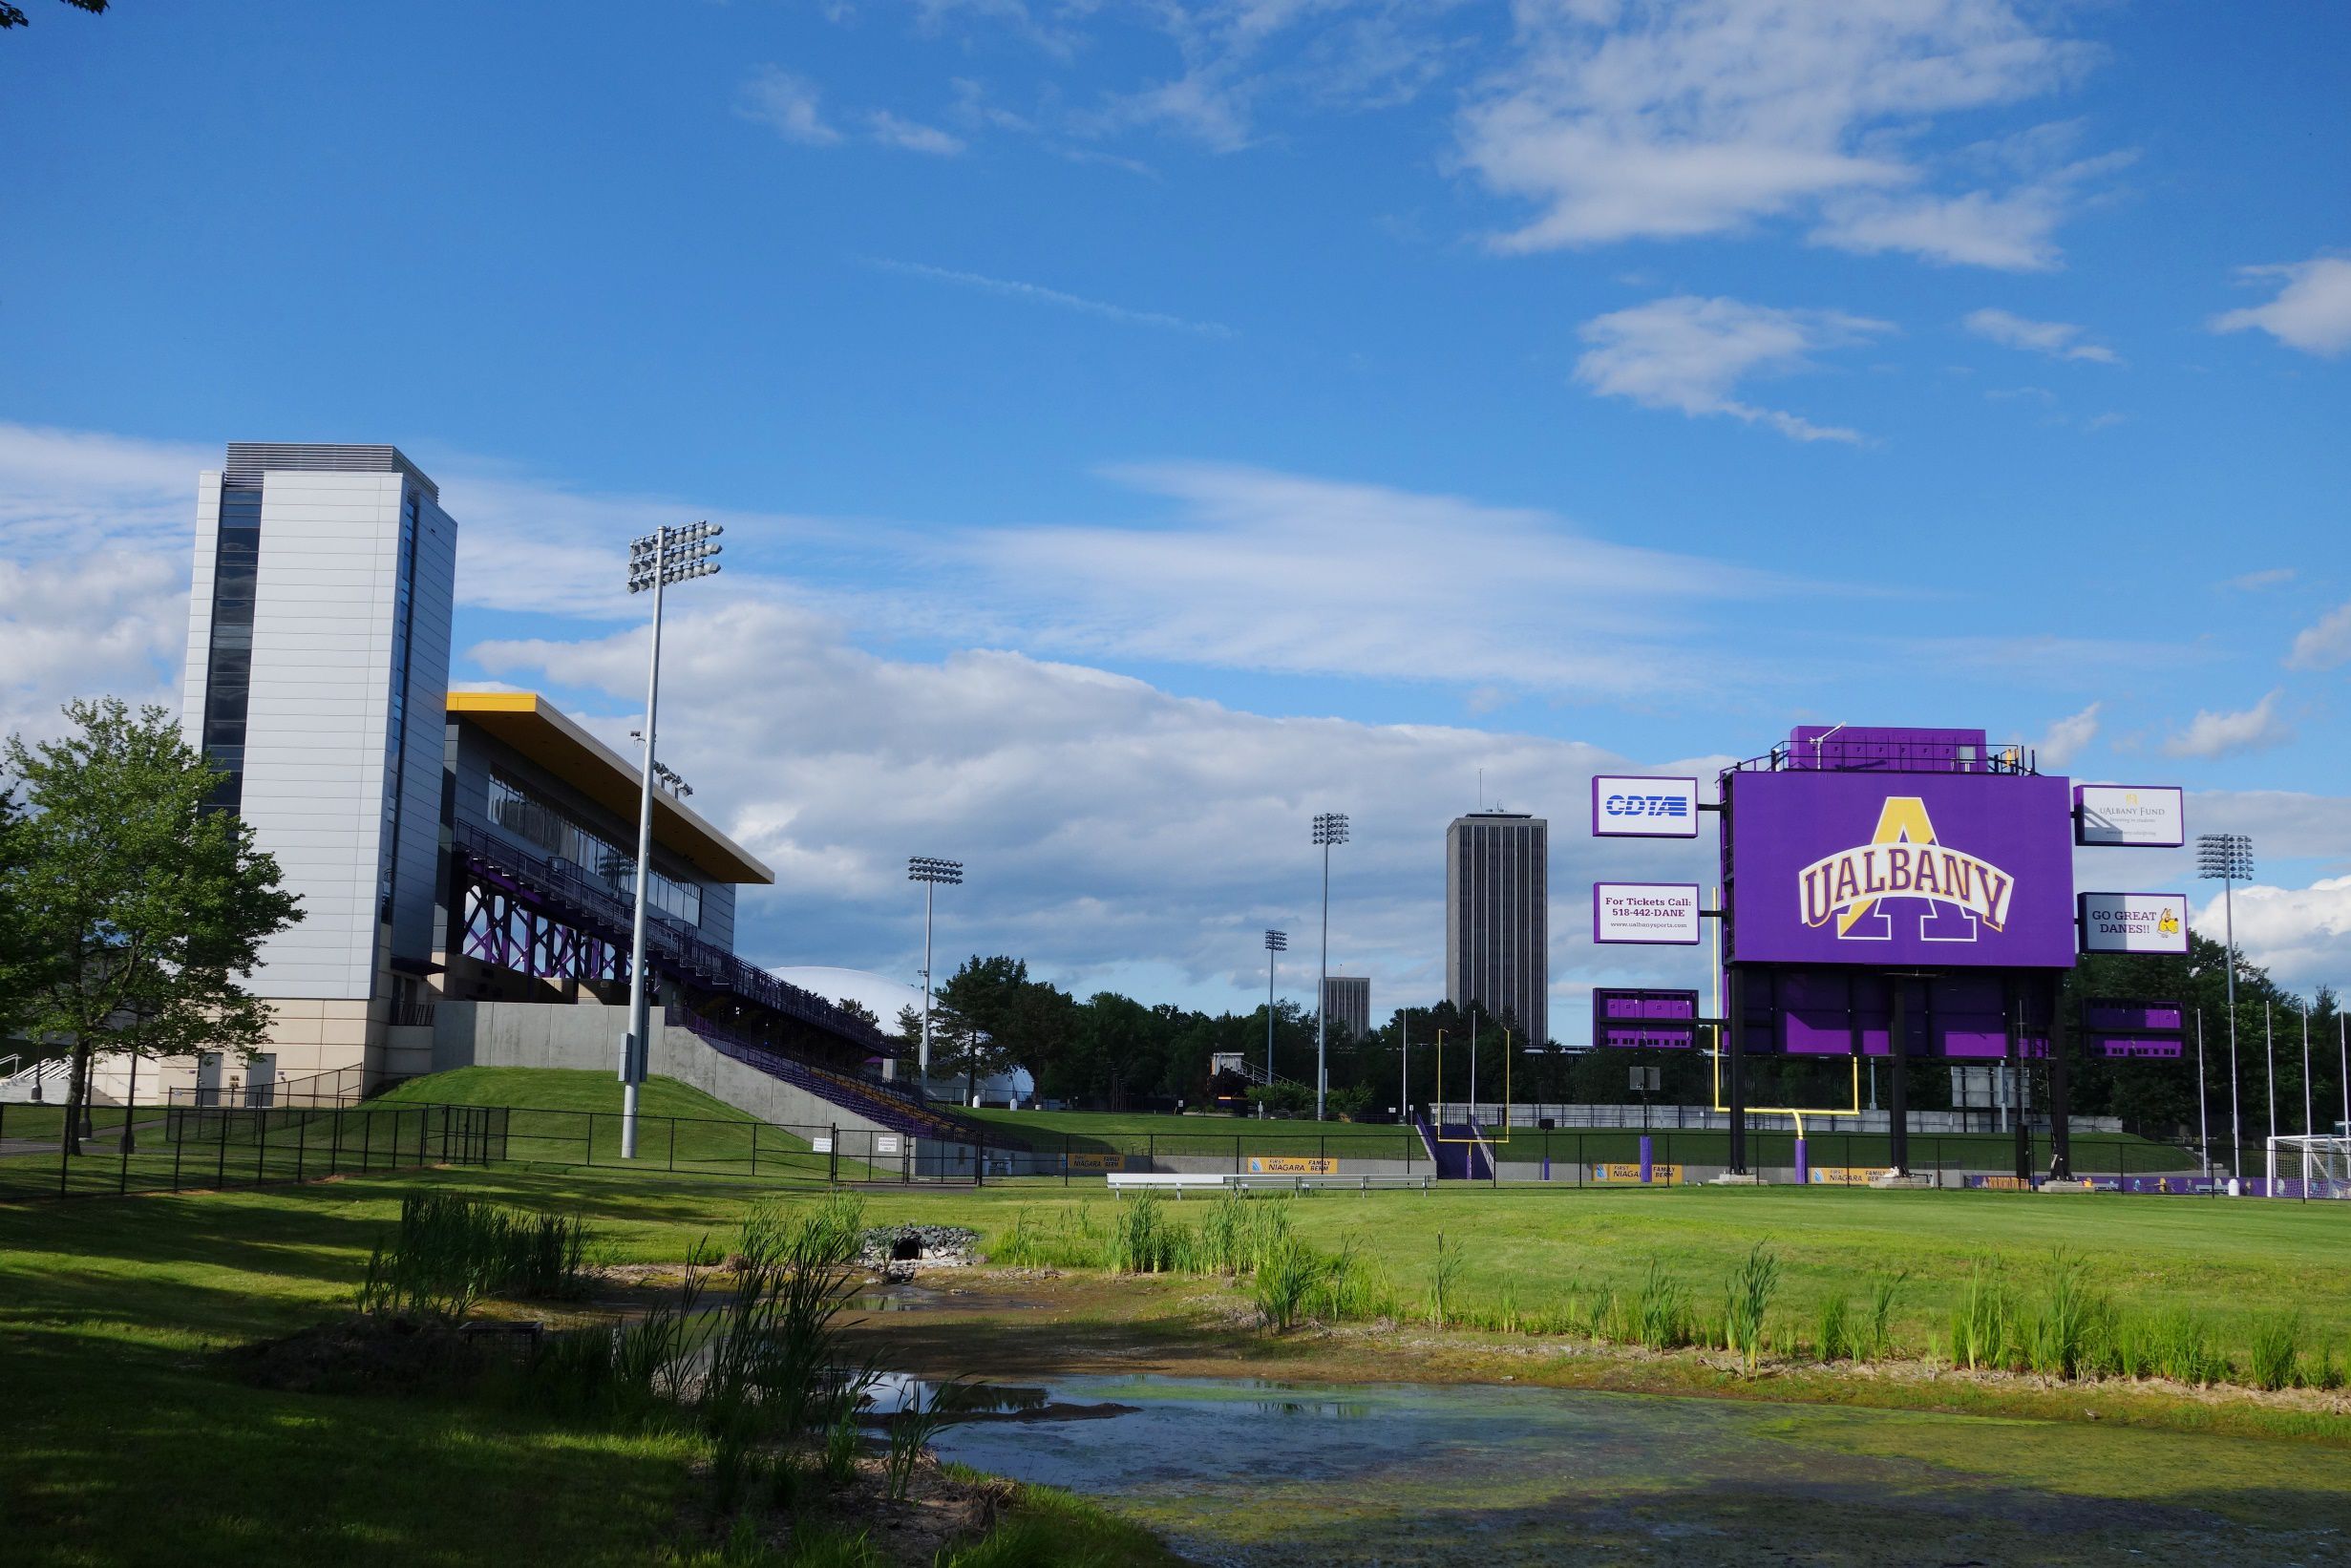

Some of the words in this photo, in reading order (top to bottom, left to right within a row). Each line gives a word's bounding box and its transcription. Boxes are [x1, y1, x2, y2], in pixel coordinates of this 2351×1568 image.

[1606, 795, 1687, 816] CDTA
[1605, 897, 1623, 905] For
[1626, 898, 1665, 906] Tickets
[1668, 898, 1691, 906] Call:
[1612, 908, 1685, 917] 518-442-DANE
[2092, 910, 2110, 921] GO
[2114, 911, 2157, 922] GREAT
[2100, 923, 2150, 934] DANES!!
[1268, 1163, 1305, 1172] NIAGARA
